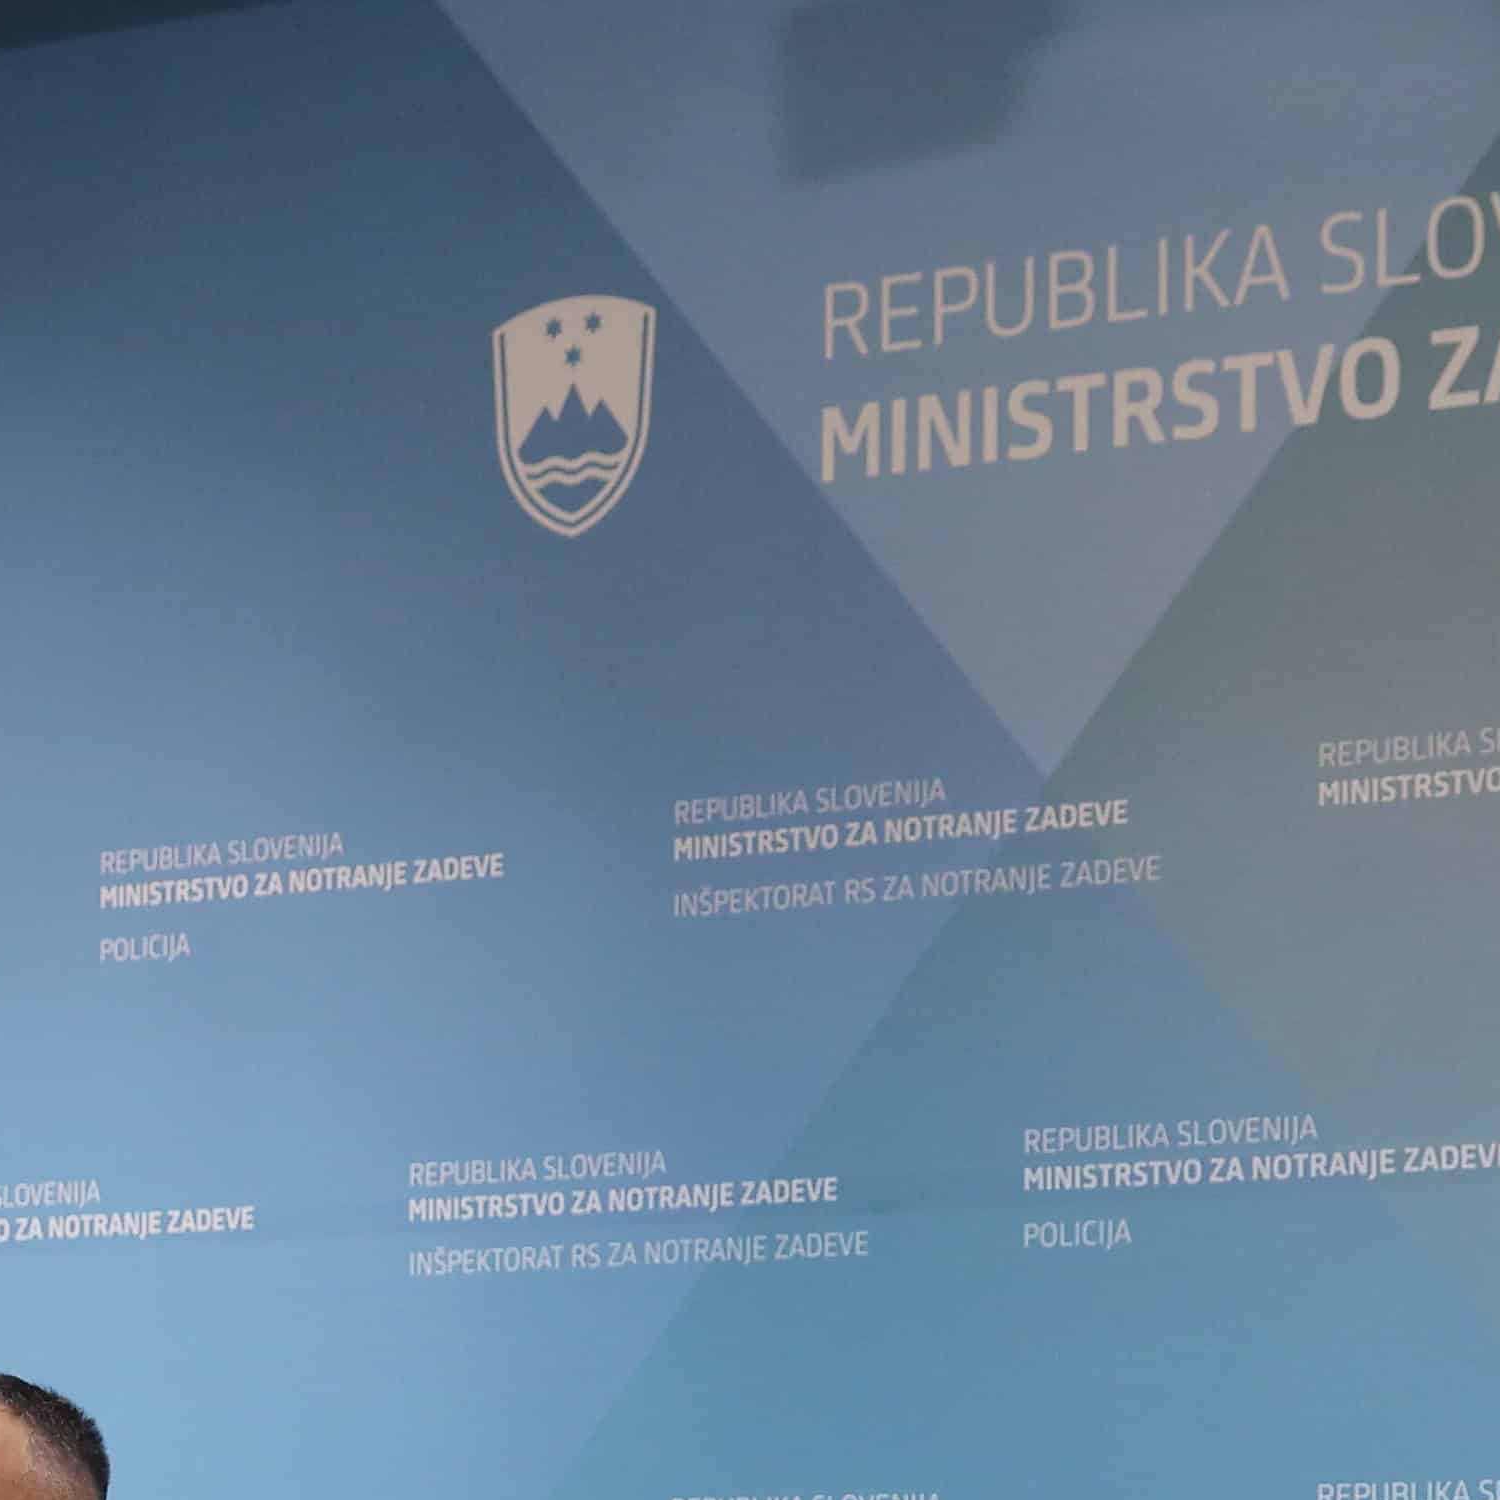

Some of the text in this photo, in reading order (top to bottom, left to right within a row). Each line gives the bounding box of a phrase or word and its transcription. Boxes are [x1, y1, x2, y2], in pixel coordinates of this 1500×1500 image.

[822, 223, 1289, 361] REPUBLIKA
[819, 335, 1401, 484] MINISTRSTVO
[1318, 729, 1471, 768] REPUBLIKA
[674, 777, 946, 825] REPUBLIKA SLOVENIJA
[100, 831, 344, 874] REPUBLIKA SLOVENIJA
[673, 799, 1128, 861] MINISTRSTVO ZA NOTRANJE ZADEVE
[100, 852, 504, 909] MINISTRSTVO ZA NOTRANJE ZADEVE
[673, 855, 1160, 917] INŠPEKTORAT RS ZA NOTRANJE ZADEVE
[99, 932, 191, 963] POLICIJA
[1024, 1113, 1318, 1154] REPUBLIKA SLOVENIJA
[409, 1149, 667, 1188] REPUBLIKA SLOVENIJA
[1023, 1158, 1202, 1191] MINISTRSTVO
[1209, 1156, 1245, 1183] ZA
[1251, 1148, 1396, 1181] NOTRANJE
[409, 1175, 838, 1222] MINISTRSTVO ZA NOTRANJE ZADEVE
[14, 1216, 44, 1241] ZA
[48, 1210, 162, 1241] NOTRANJE
[167, 1205, 255, 1234] ZADEVE
[1023, 1218, 1132, 1249] POLICIJA
[409, 1229, 869, 1276] INŠPEKTORAT RS ZA NOTRANJE ZADEVE
